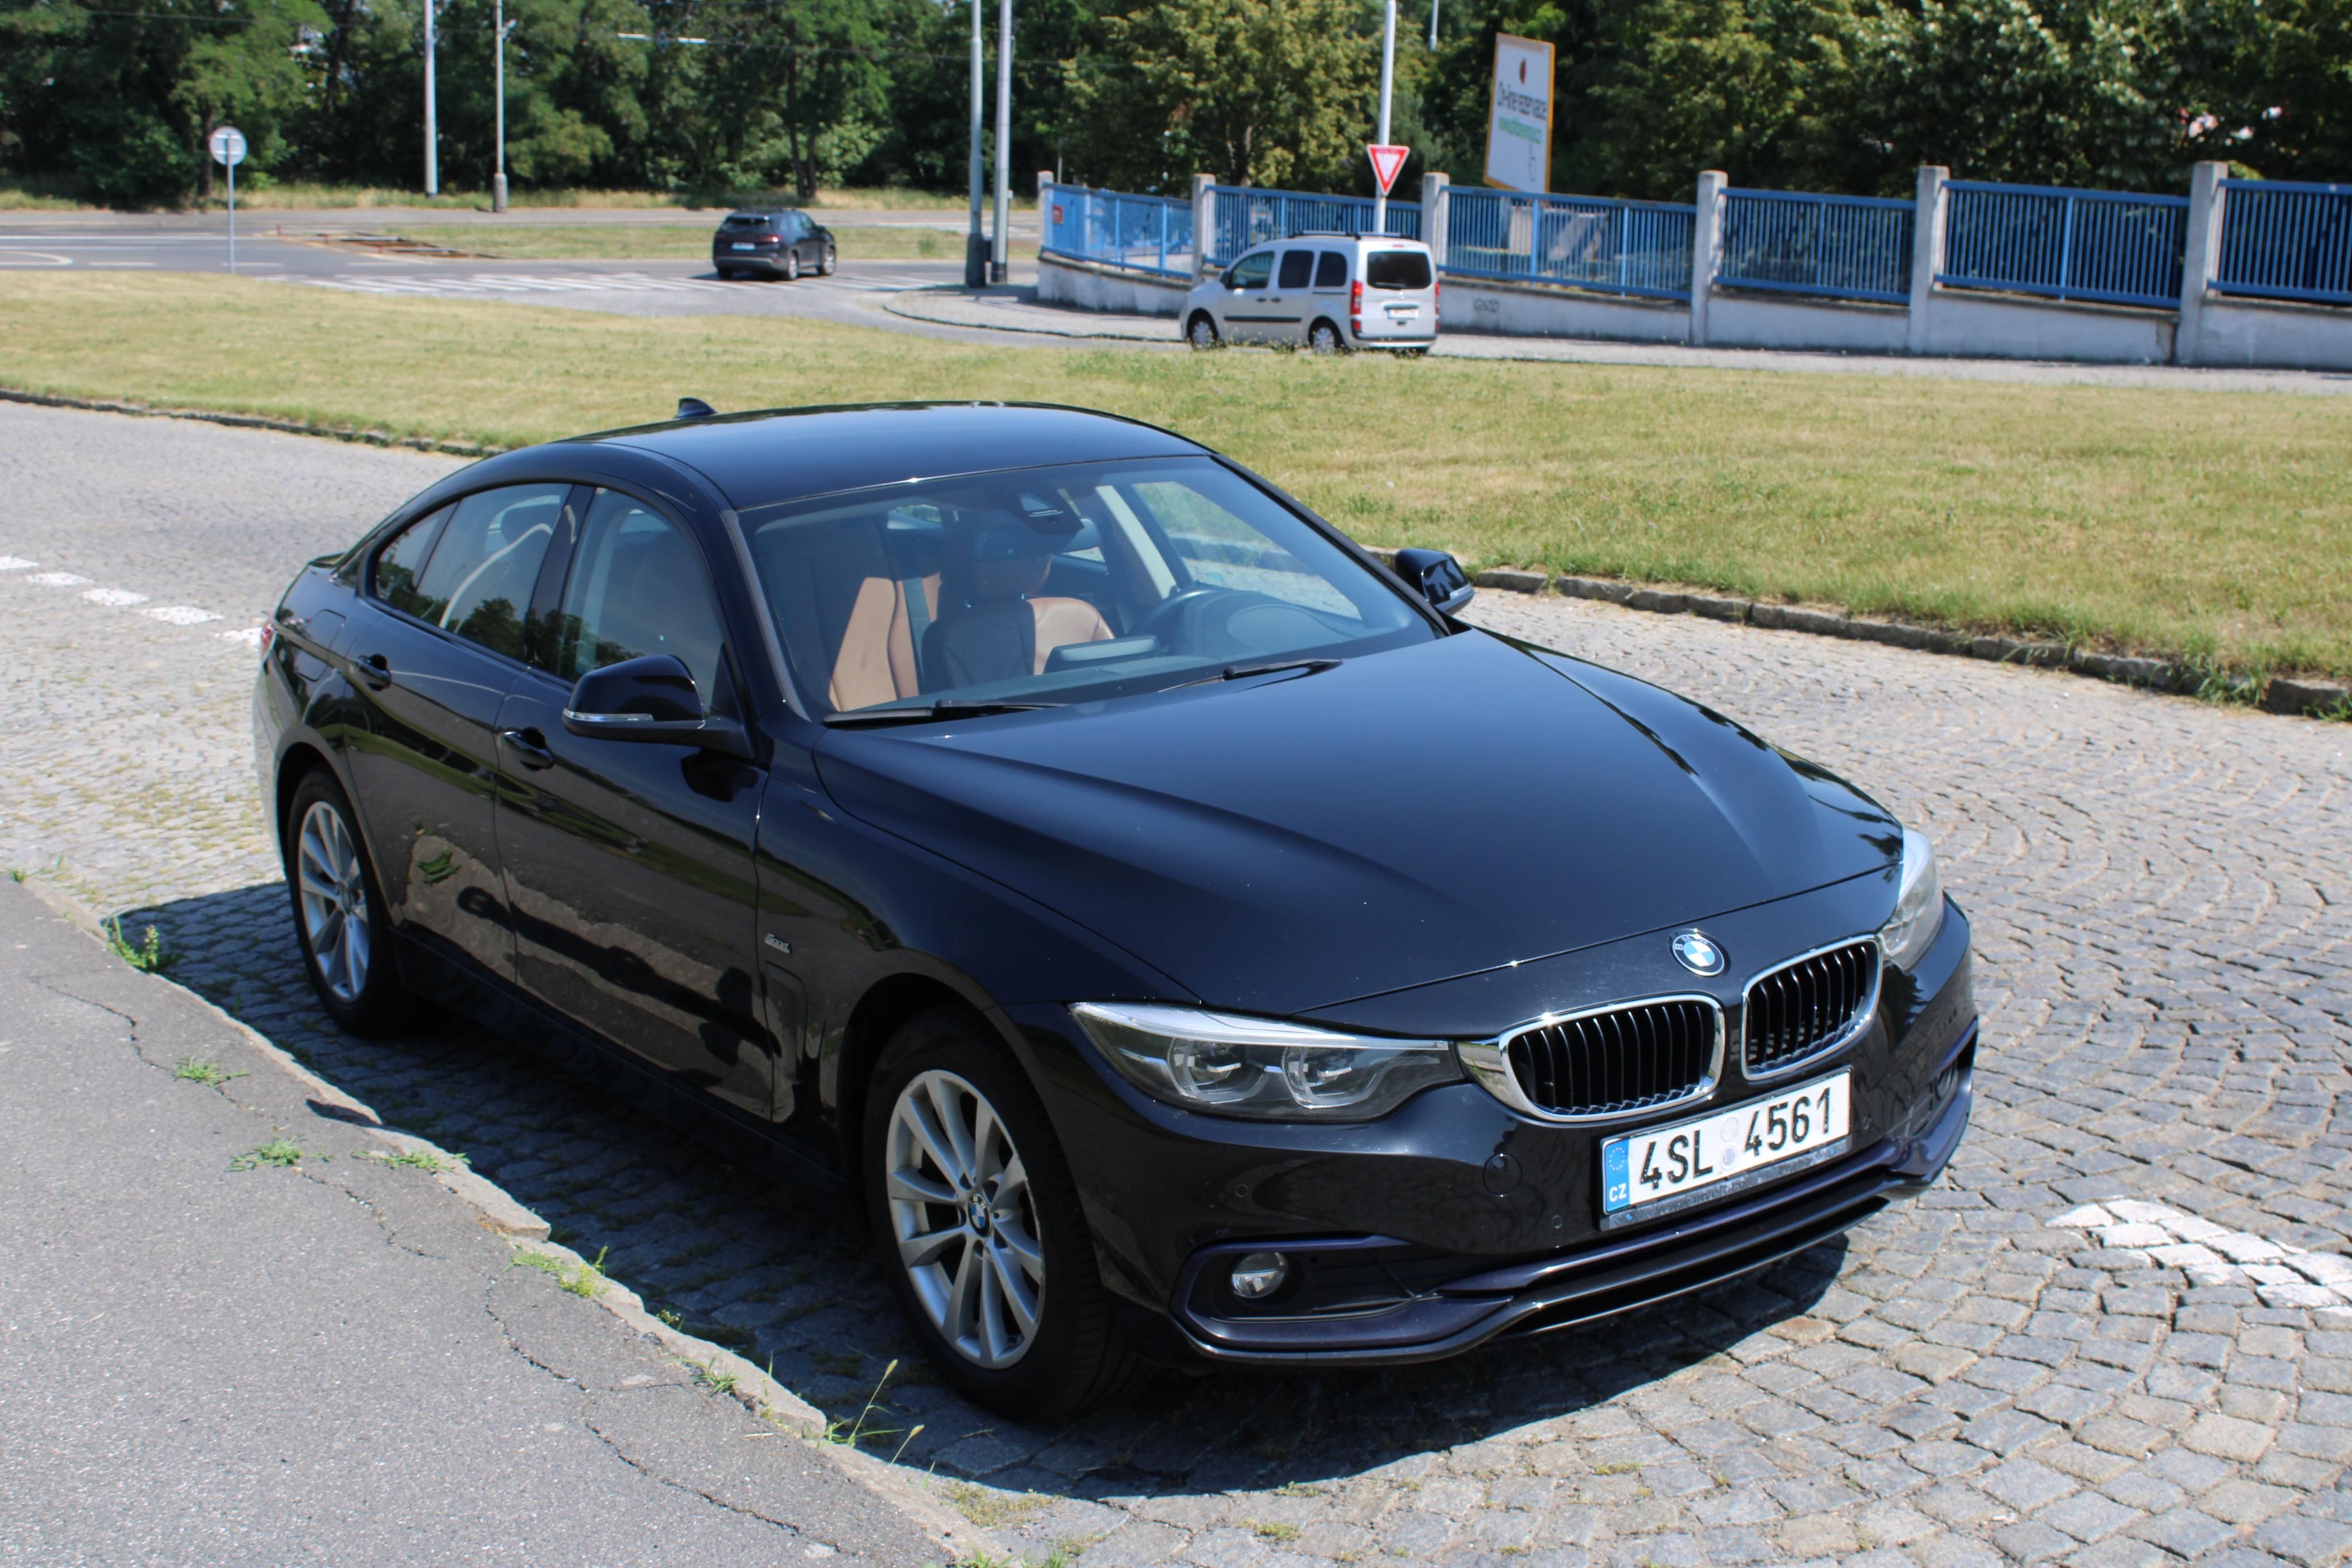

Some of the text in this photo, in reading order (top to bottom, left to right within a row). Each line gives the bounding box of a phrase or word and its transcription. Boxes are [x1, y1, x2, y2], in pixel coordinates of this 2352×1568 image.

[1639, 1129, 1713, 1190] 4SL
[1744, 1086, 1831, 1157] 4561
[1609, 1183, 1627, 1202] CZ
